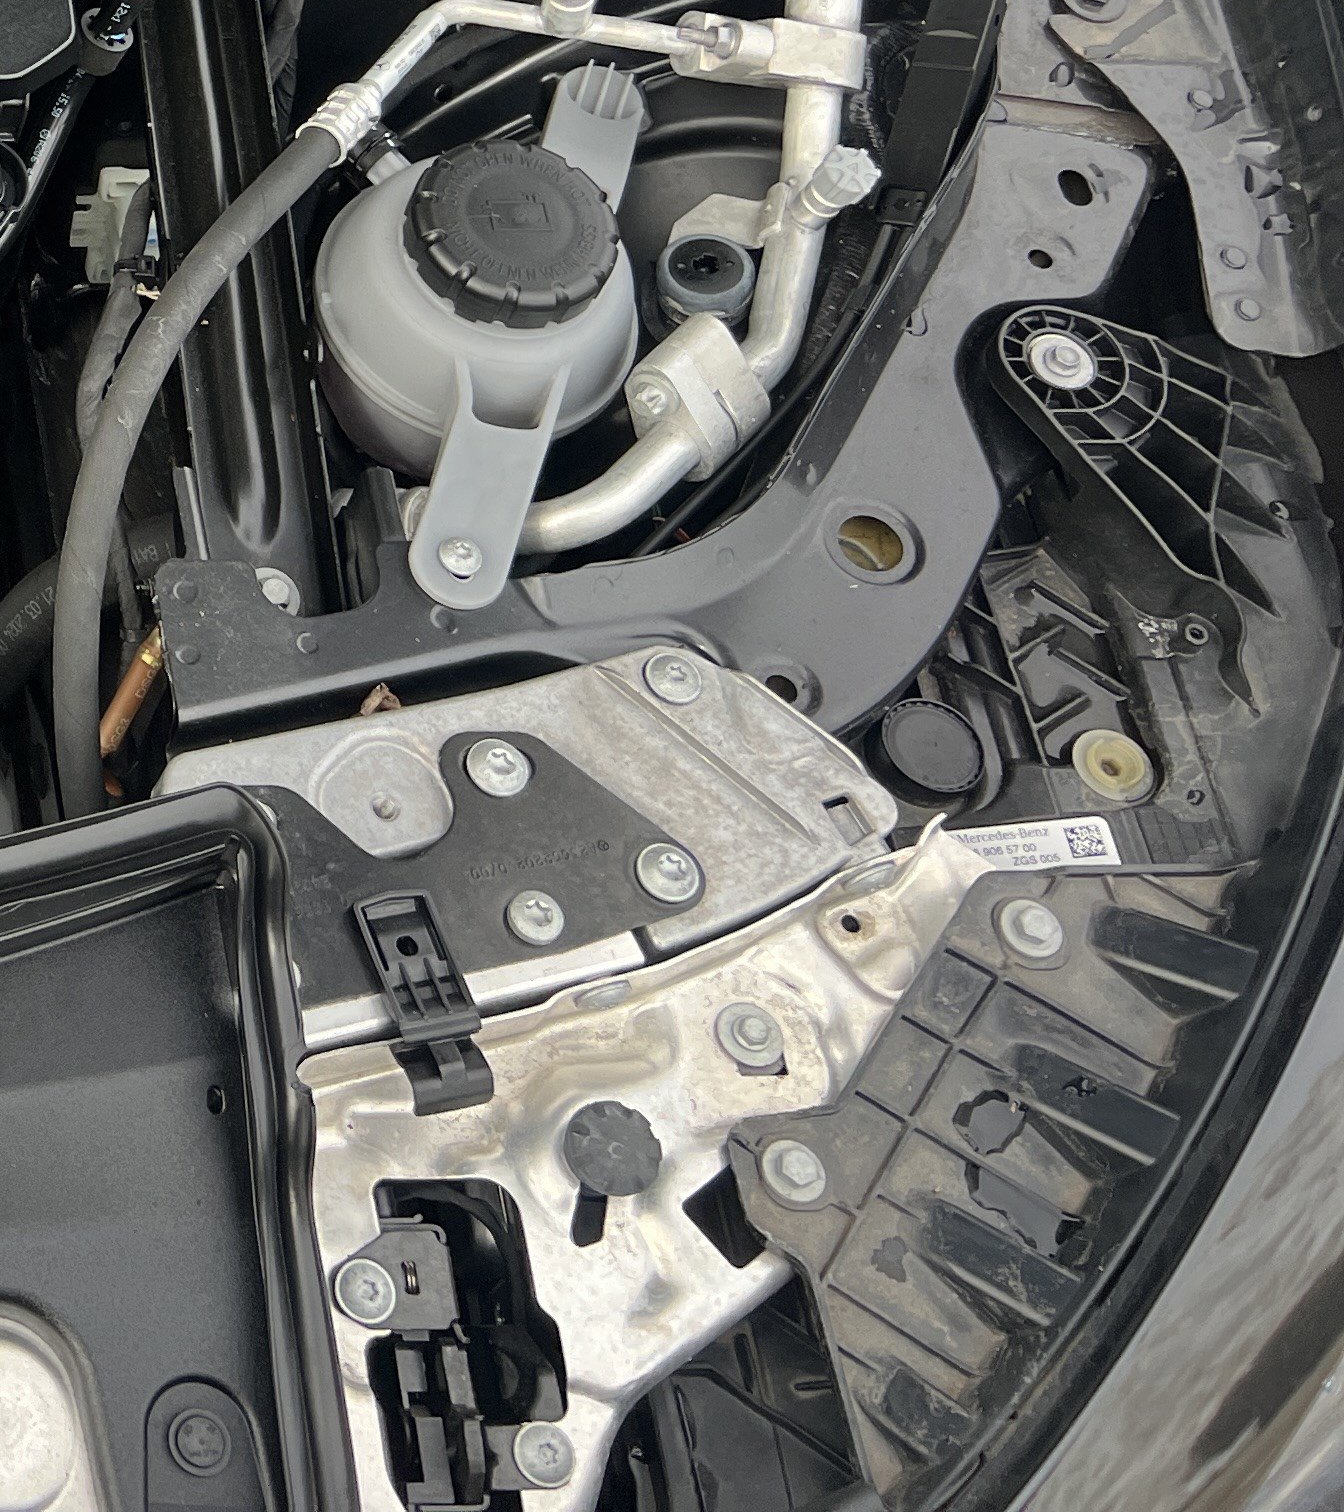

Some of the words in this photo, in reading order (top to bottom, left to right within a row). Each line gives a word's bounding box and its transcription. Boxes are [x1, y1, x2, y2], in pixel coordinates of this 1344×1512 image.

[956, 827, 1050, 845] Mercedes-Benz
[983, 844, 1004, 857] 906
[1005, 844, 1019, 855] 57
[1022, 843, 1037, 853] 00
[1012, 855, 1038, 867] ZGS
[1039, 853, 1061, 864] 005
